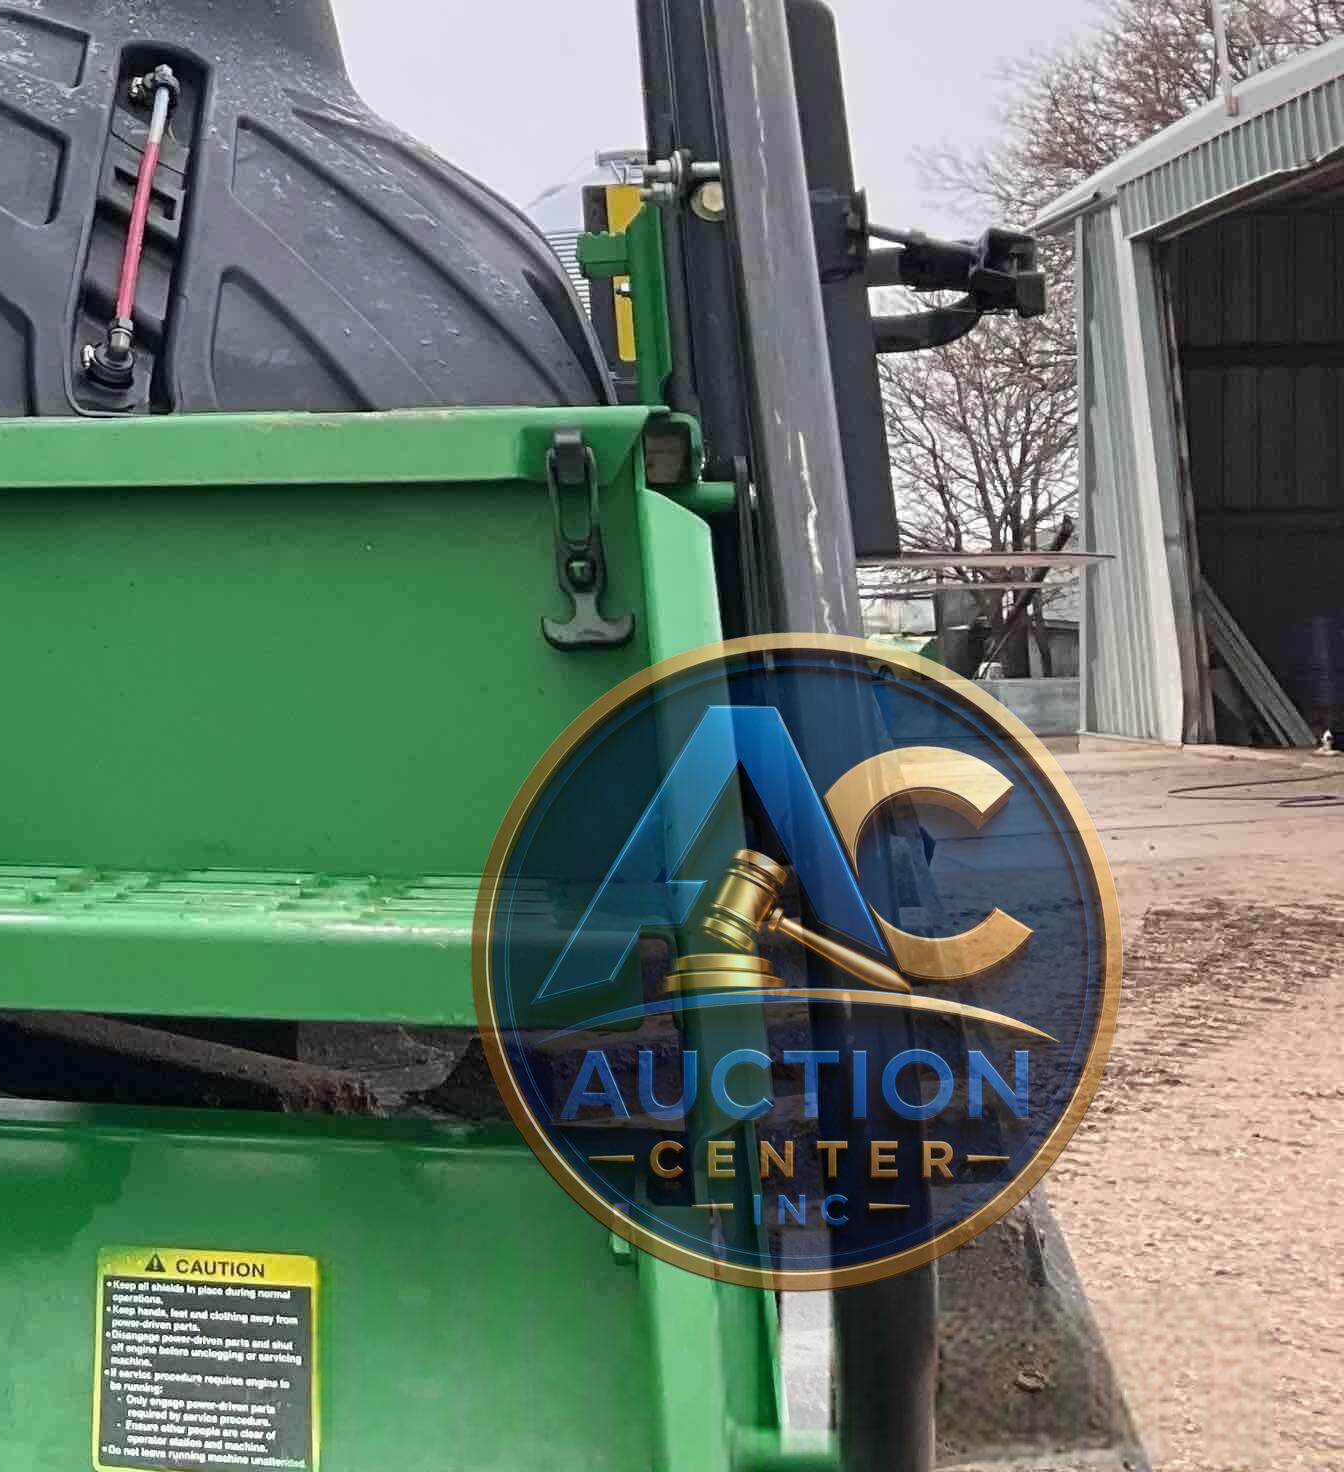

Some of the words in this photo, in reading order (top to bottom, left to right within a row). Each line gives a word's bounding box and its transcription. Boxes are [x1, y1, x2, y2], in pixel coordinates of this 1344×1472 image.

[175, 1259, 265, 1277] CAUTION
[225, 1287, 256, 1299] during
[209, 1311, 248, 1324] clothing
